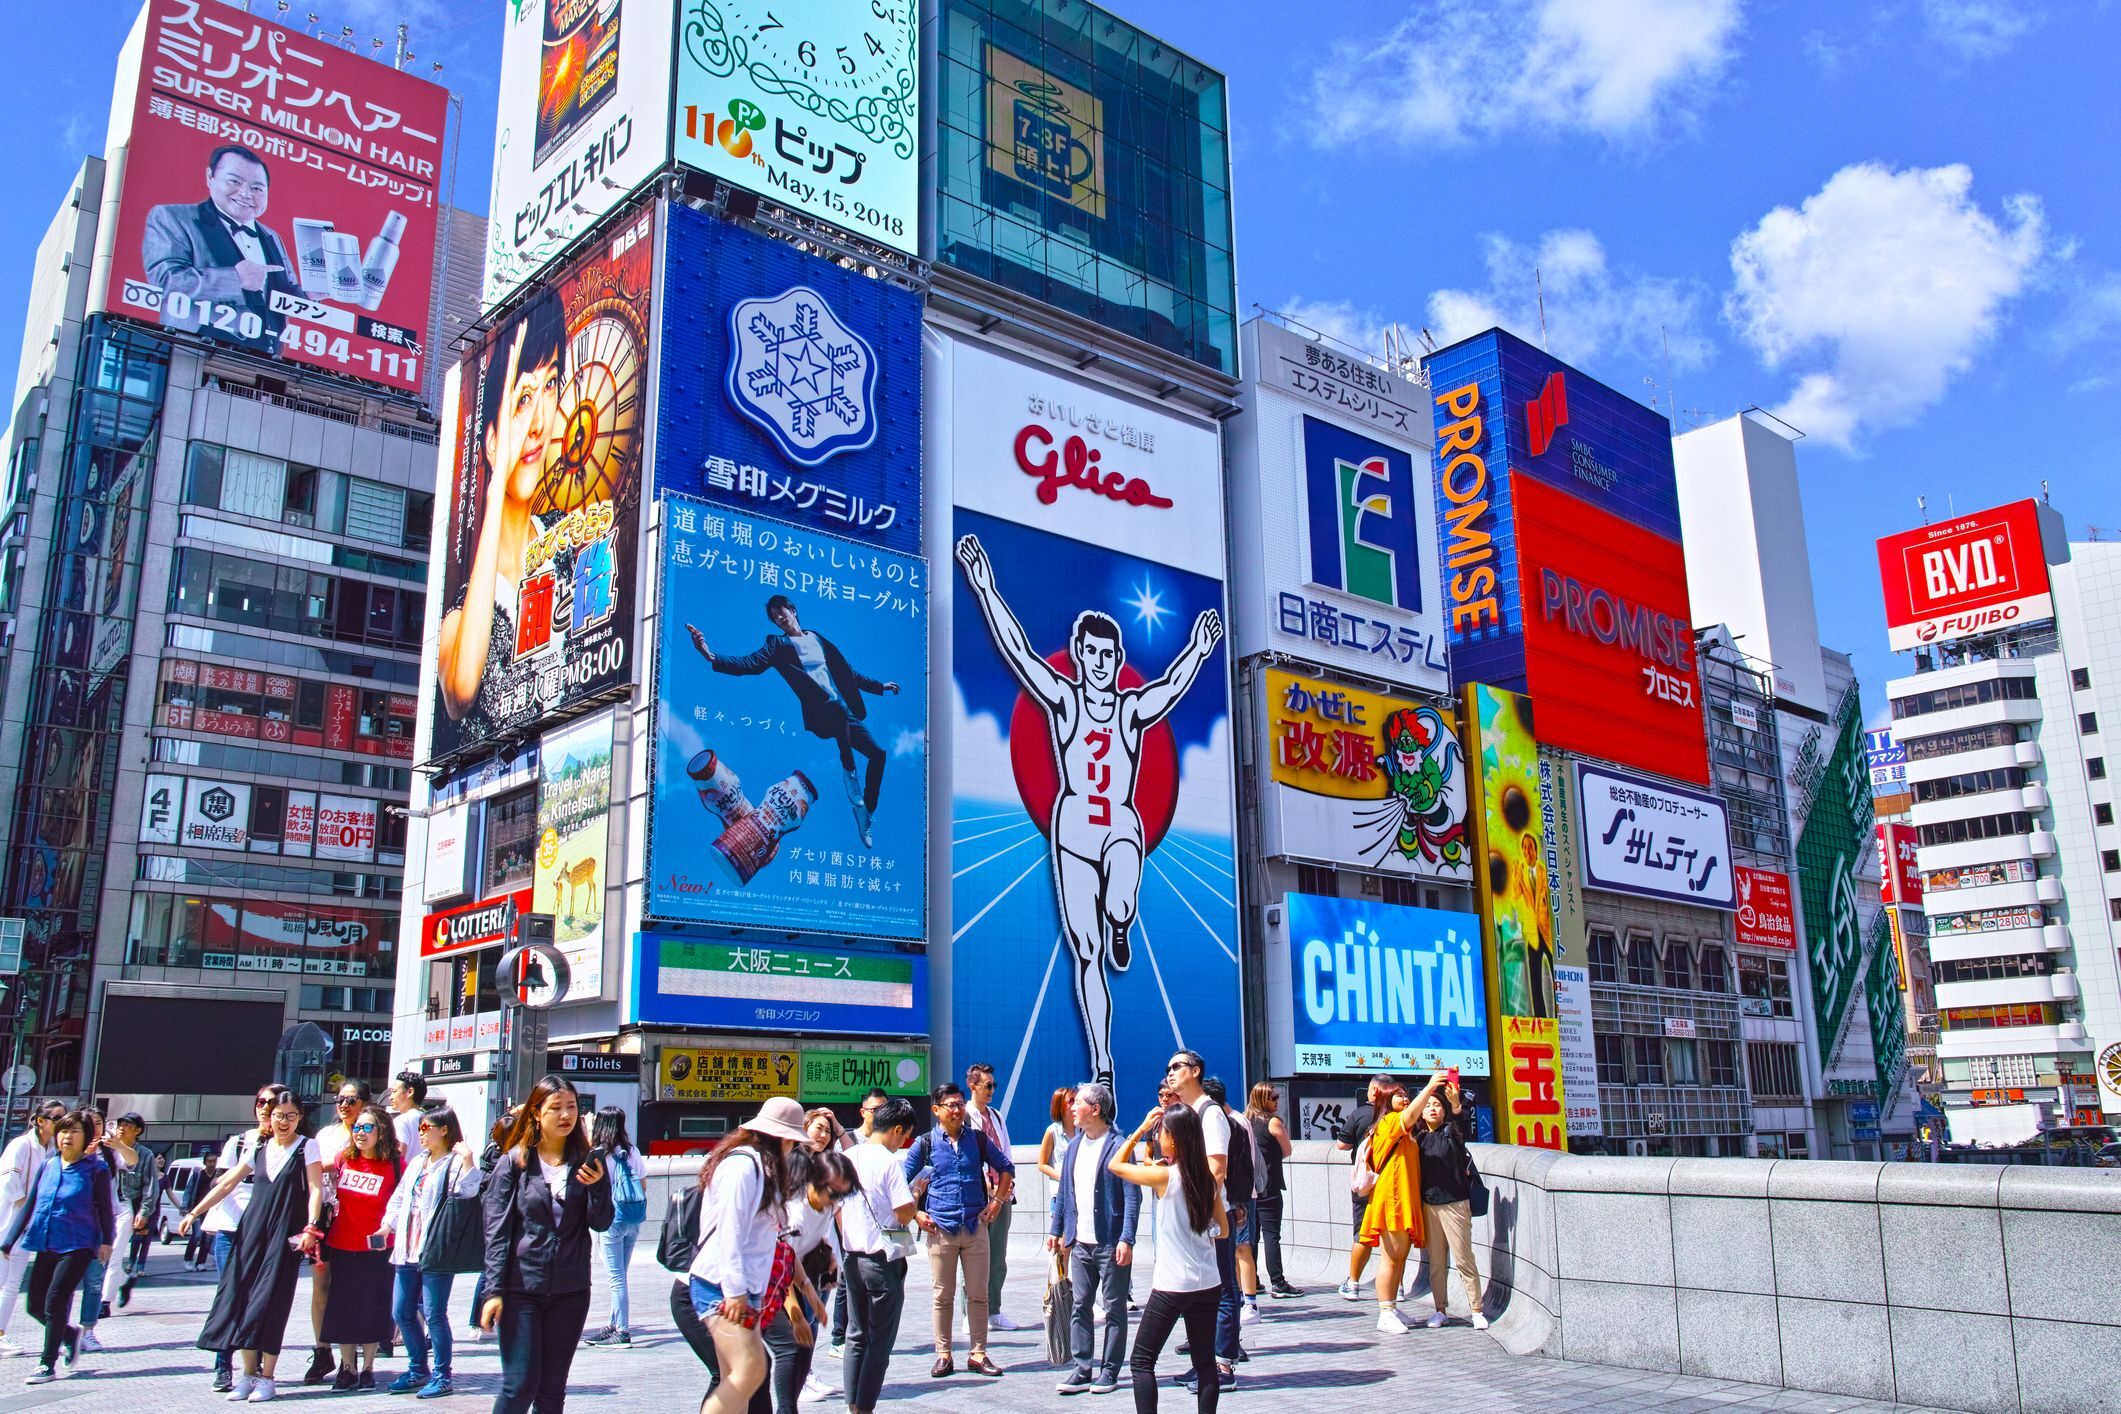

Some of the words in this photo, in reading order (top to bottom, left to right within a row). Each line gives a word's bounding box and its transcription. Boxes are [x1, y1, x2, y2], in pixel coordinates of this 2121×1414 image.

[798, 41, 816, 67] 6
[864, 32, 885, 56] 4
[836, 46, 856, 74] 5
[157, 27, 437, 143] ミリオンヘアー
[152, 66, 252, 115] SUPER
[261, 104, 362, 153] MILLION
[370, 146, 434, 178] HAIR
[1018, 115, 1067, 153] 7-8F
[751, 151, 766, 168] th
[775, 117, 866, 185] ピップ
[514, 118, 634, 248] ピップエレキバン
[768, 165, 818, 203] May.
[823, 188, 850, 218] 15,
[856, 208, 904, 237] 2018
[612, 218, 650, 262] MBS
[274, 296, 328, 320] ルアン
[166, 291, 418, 383] 0120-494-111
[370, 322, 404, 344] 検索
[1304, 344, 1392, 394] 夢ある住まい
[1291, 369, 1409, 432] エステムシリーズ
[1029, 393, 1155, 453] おいしさと健康
[1571, 438, 1595, 459] SMBC
[1014, 424, 1174, 509] Glico
[1572, 451, 1618, 484] CONSUMER
[1573, 464, 1611, 492] FINANCE
[704, 455, 896, 530] 雪印メグミルク
[1436, 382, 1499, 633] PROMISE
[1928, 525, 1953, 539] Since
[673, 506, 920, 589] 道頓堀のおいしいものと
[1922, 538, 2006, 600] B.V.D.
[1279, 591, 1449, 673] 日商エステム
[1540, 567, 1692, 672] PROMISE
[1942, 605, 2019, 635] FUJIBO
[175, 665, 196, 680] 焼肉
[500, 666, 560, 718] 毎週火曜
[560, 661, 580, 691] PM
[580, 638, 624, 684] 8:00
[1643, 666, 1695, 708] プロミス
[169, 708, 192, 725] 5F
[1284, 682, 1366, 725] かぜに
[693, 705, 797, 737] 軽々、つづく。
[1277, 719, 1377, 782] 改源
[1957, 732, 1985, 743] RIDE
[543, 773, 573, 800] Travel
[582, 765, 608, 787] Nara
[1084, 727, 1113, 827] グリコ
[150, 788, 171, 829] 4F
[288, 805, 376, 827] 女性のお客様
[551, 794, 598, 820] Kintetsu.
[1609, 785, 1709, 820] 総合不動産のプロデューサー
[186, 822, 239, 844] 相席屋
[287, 819, 340, 837] 飲み放題
[340, 826, 375, 849] 0円
[790, 847, 895, 870] ガセリ菌SP株が
[1539, 759, 1567, 960] 株式会社日本リート
[658, 874, 714, 894] New!
[789, 869, 902, 893] 内臓脂肪を減らす
[1812, 855, 1857, 1022] エイブル
[204, 955, 235, 967] 営業時間
[239, 960, 253, 968] AM
[728, 948, 853, 978] 大阪ニュース
[1554, 970, 1584, 982] NIHON
[755, 1008, 821, 1022] 雪印メグミルク
[1508, 1017, 1554, 1037] スーパー
[442, 1059, 461, 1073] Toilets
[580, 1056, 621, 1071] Toilets
[842, 1058, 892, 1087] ピタットハウス
[1303, 1053, 1331, 1066] 天気予報
[342, 1173, 378, 1191] 1978
